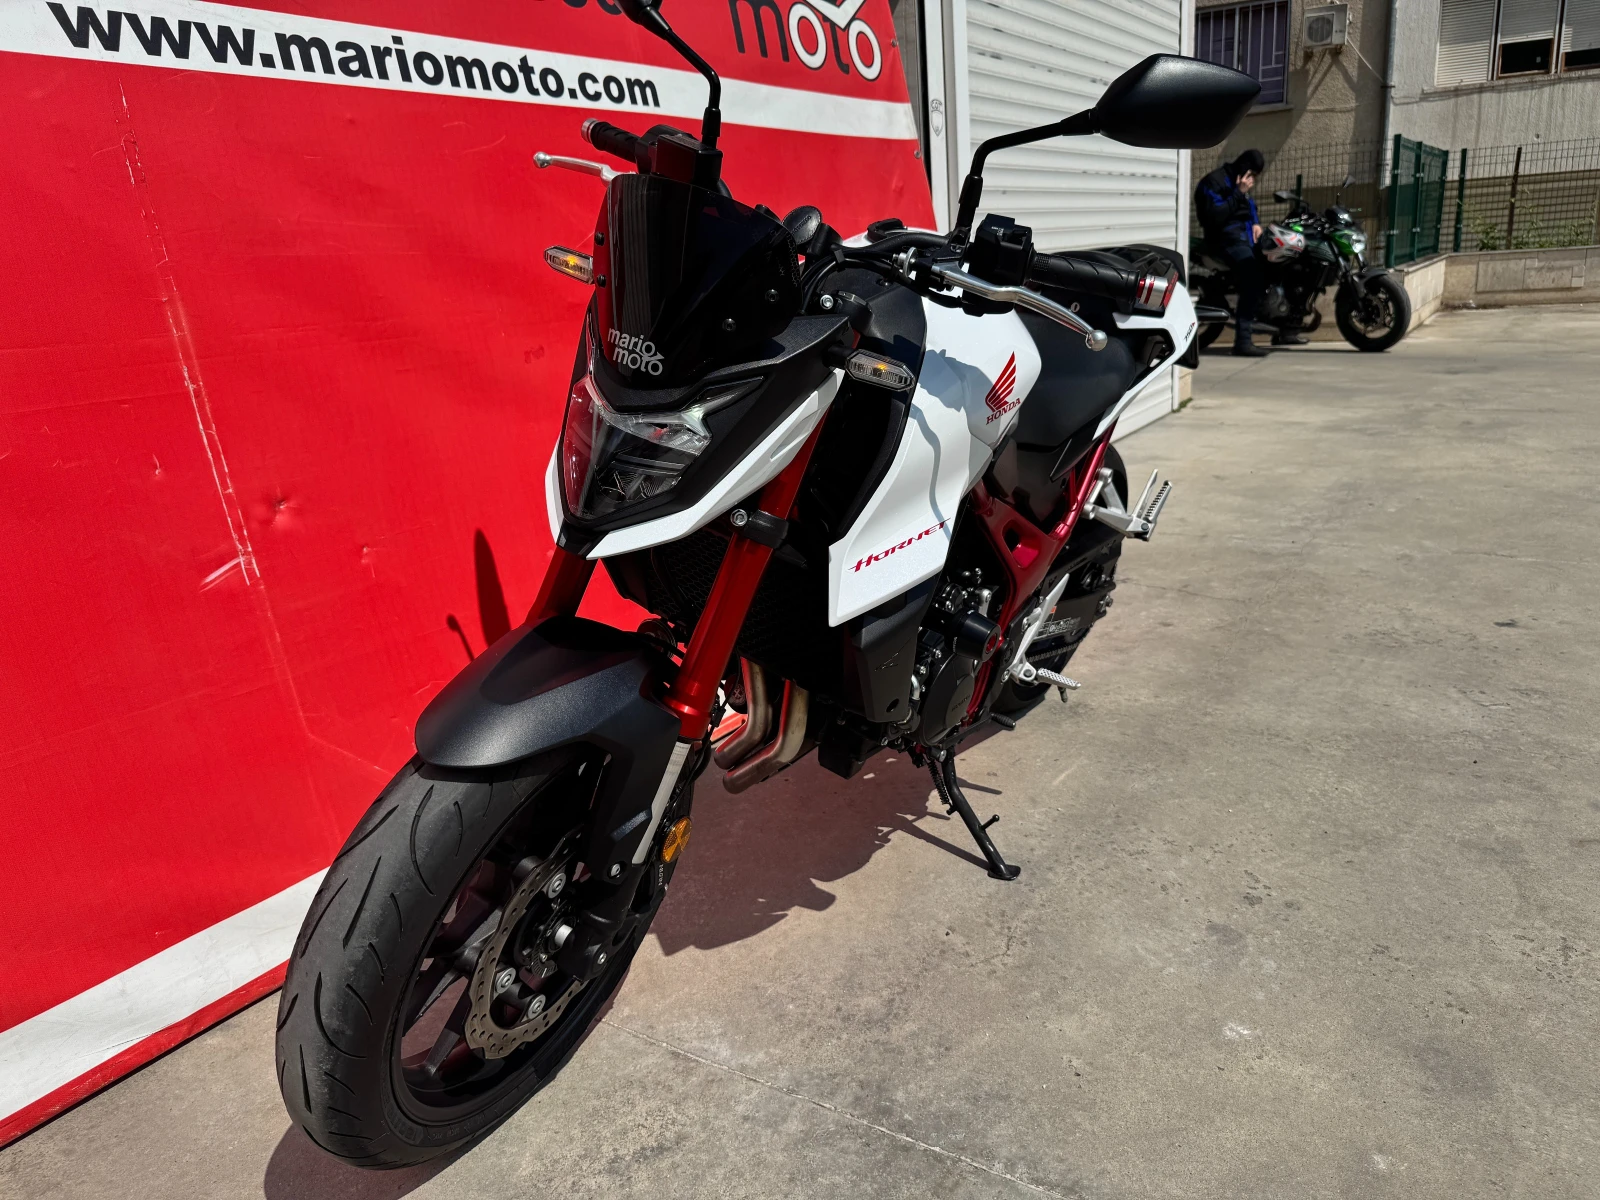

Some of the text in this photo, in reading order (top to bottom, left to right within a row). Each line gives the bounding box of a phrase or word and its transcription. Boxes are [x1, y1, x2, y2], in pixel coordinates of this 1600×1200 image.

[46, 1, 661, 107] www.mariomoto.com
[728, 0, 883, 82] moto
[607, 327, 656, 357] mario
[613, 347, 664, 376] moto
[985, 398, 1021, 426] HONDA
